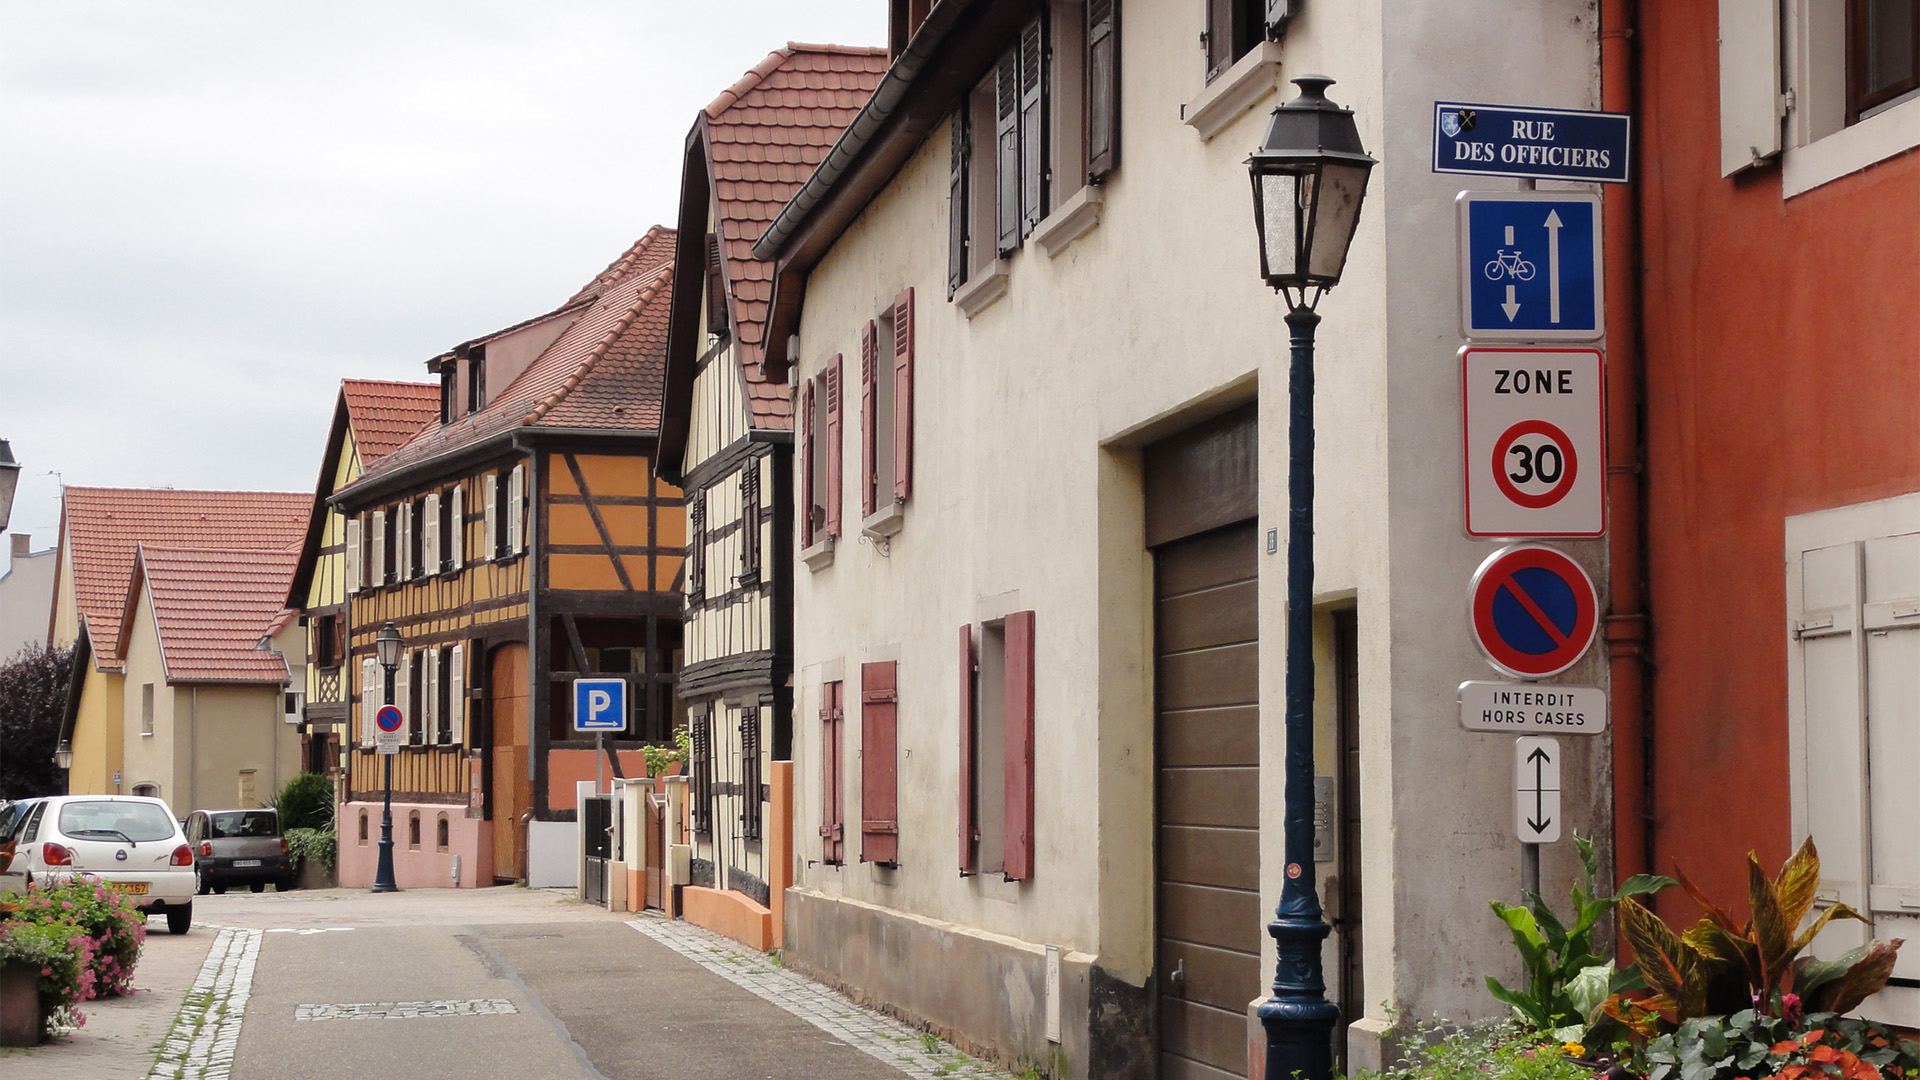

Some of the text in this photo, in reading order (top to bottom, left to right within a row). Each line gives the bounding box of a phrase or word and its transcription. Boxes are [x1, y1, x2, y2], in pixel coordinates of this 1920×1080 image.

[1512, 120, 1555, 140] RUE
[1454, 141, 1610, 168] DES OFFICIERS
[1494, 370, 1573, 394] ZONE
[1509, 444, 1562, 484] 30
[589, 690, 611, 720] P
[1494, 692, 1574, 707] INTERDIT
[1482, 710, 1585, 726] HORS CASES
